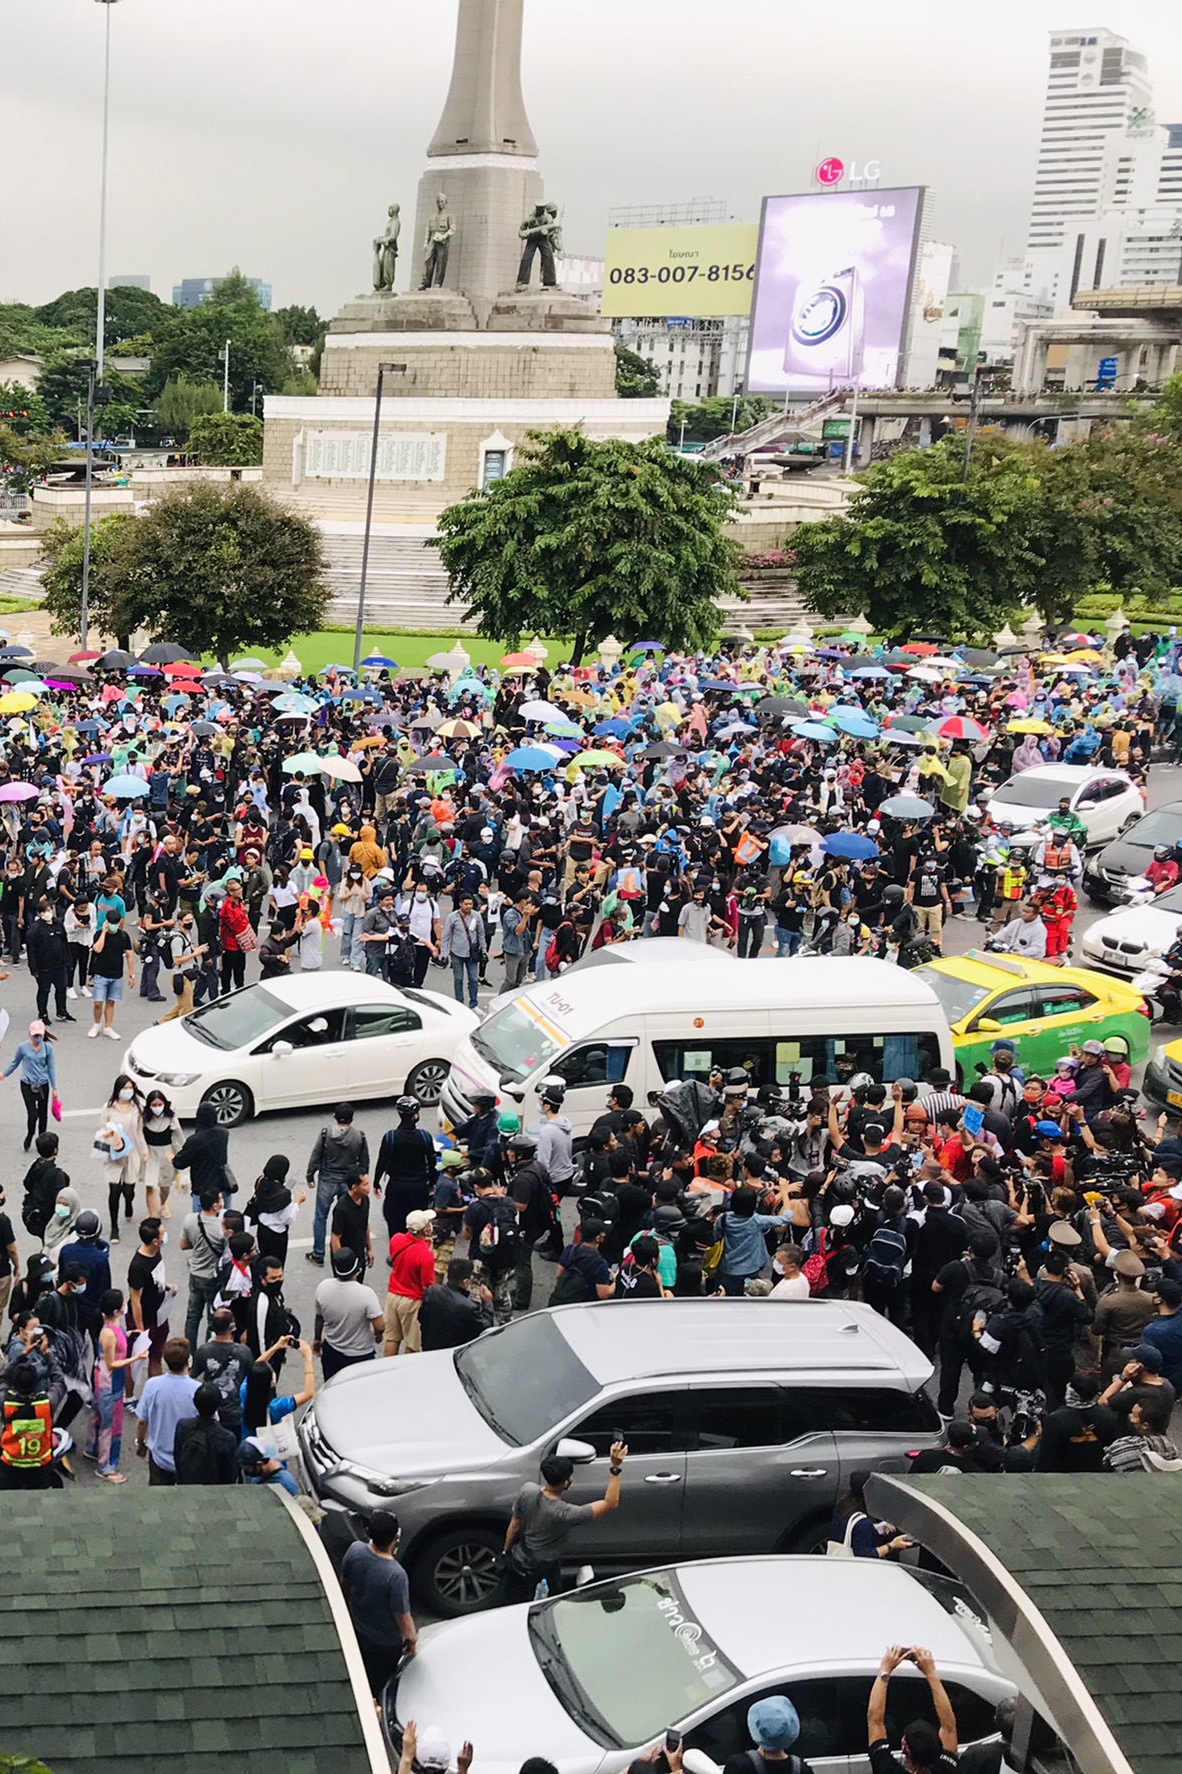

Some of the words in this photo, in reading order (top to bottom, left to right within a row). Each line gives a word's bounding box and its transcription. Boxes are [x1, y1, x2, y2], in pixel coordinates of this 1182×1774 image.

[849, 160, 881, 181] LG
[668, 249, 699, 259] โฆษณา
[609, 263, 756, 284] 083-007-8156
[547, 992, 575, 1016] TU-01
[19, 1436, 41, 1456] 19
